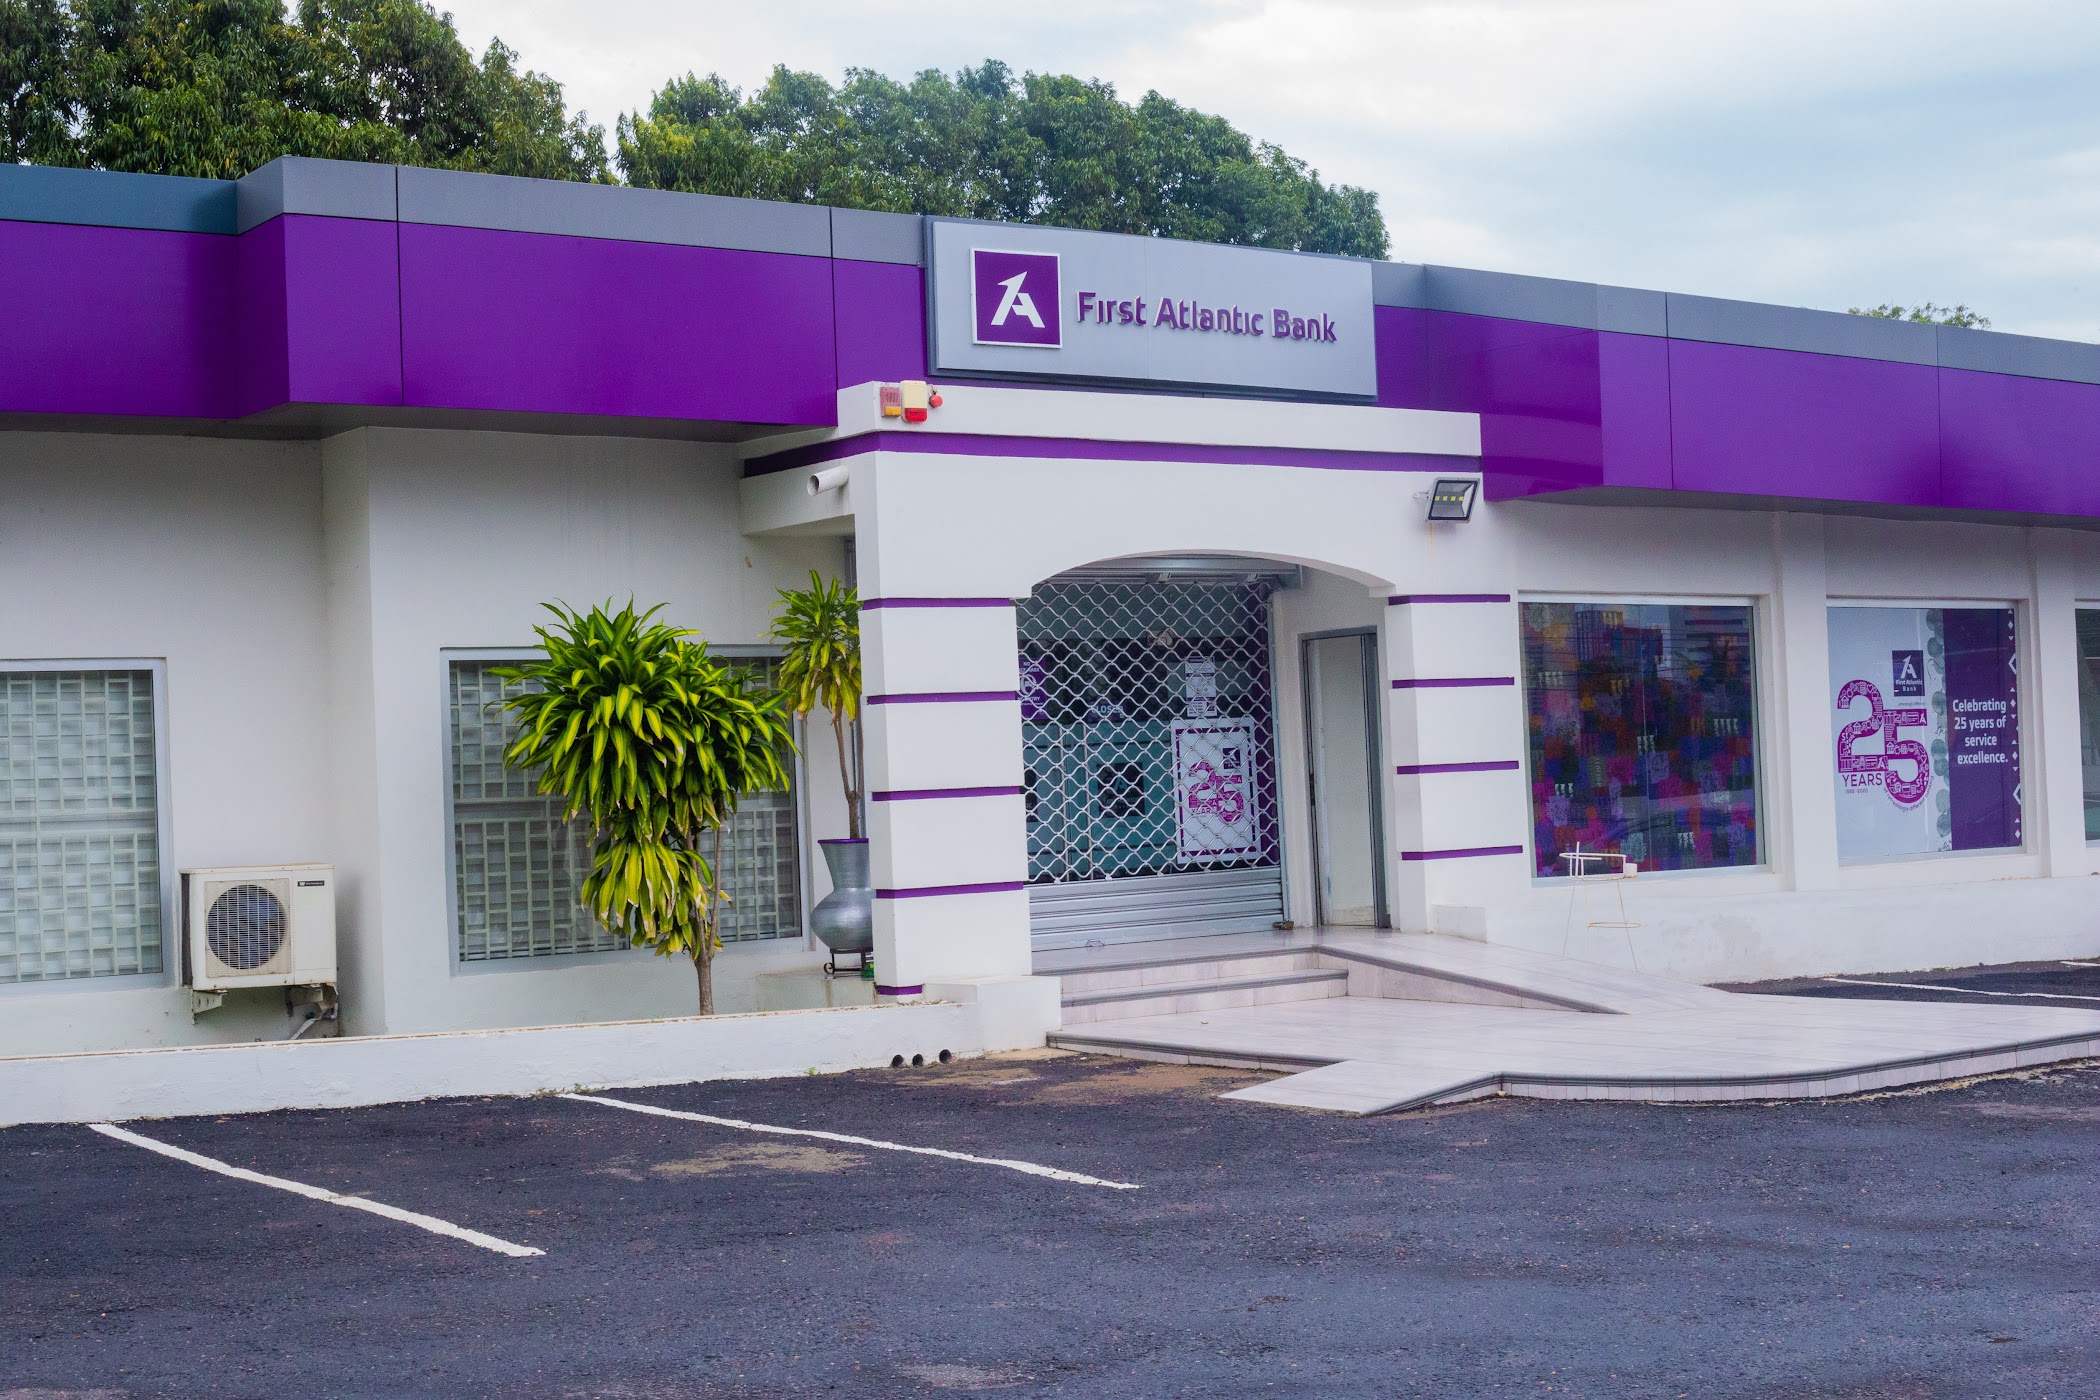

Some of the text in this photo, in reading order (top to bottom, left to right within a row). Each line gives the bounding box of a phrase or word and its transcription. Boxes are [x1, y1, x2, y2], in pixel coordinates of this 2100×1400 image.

[1077, 291, 1338, 342] First Atlantic Bank
[1952, 698, 2007, 714] Celebrating
[1954, 715, 2007, 732] 25 years of
[1837, 680, 1930, 803] 25
[1964, 733, 1998, 747] service
[1957, 750, 2009, 765] excellence.
[1842, 773, 1883, 787] YEARS
